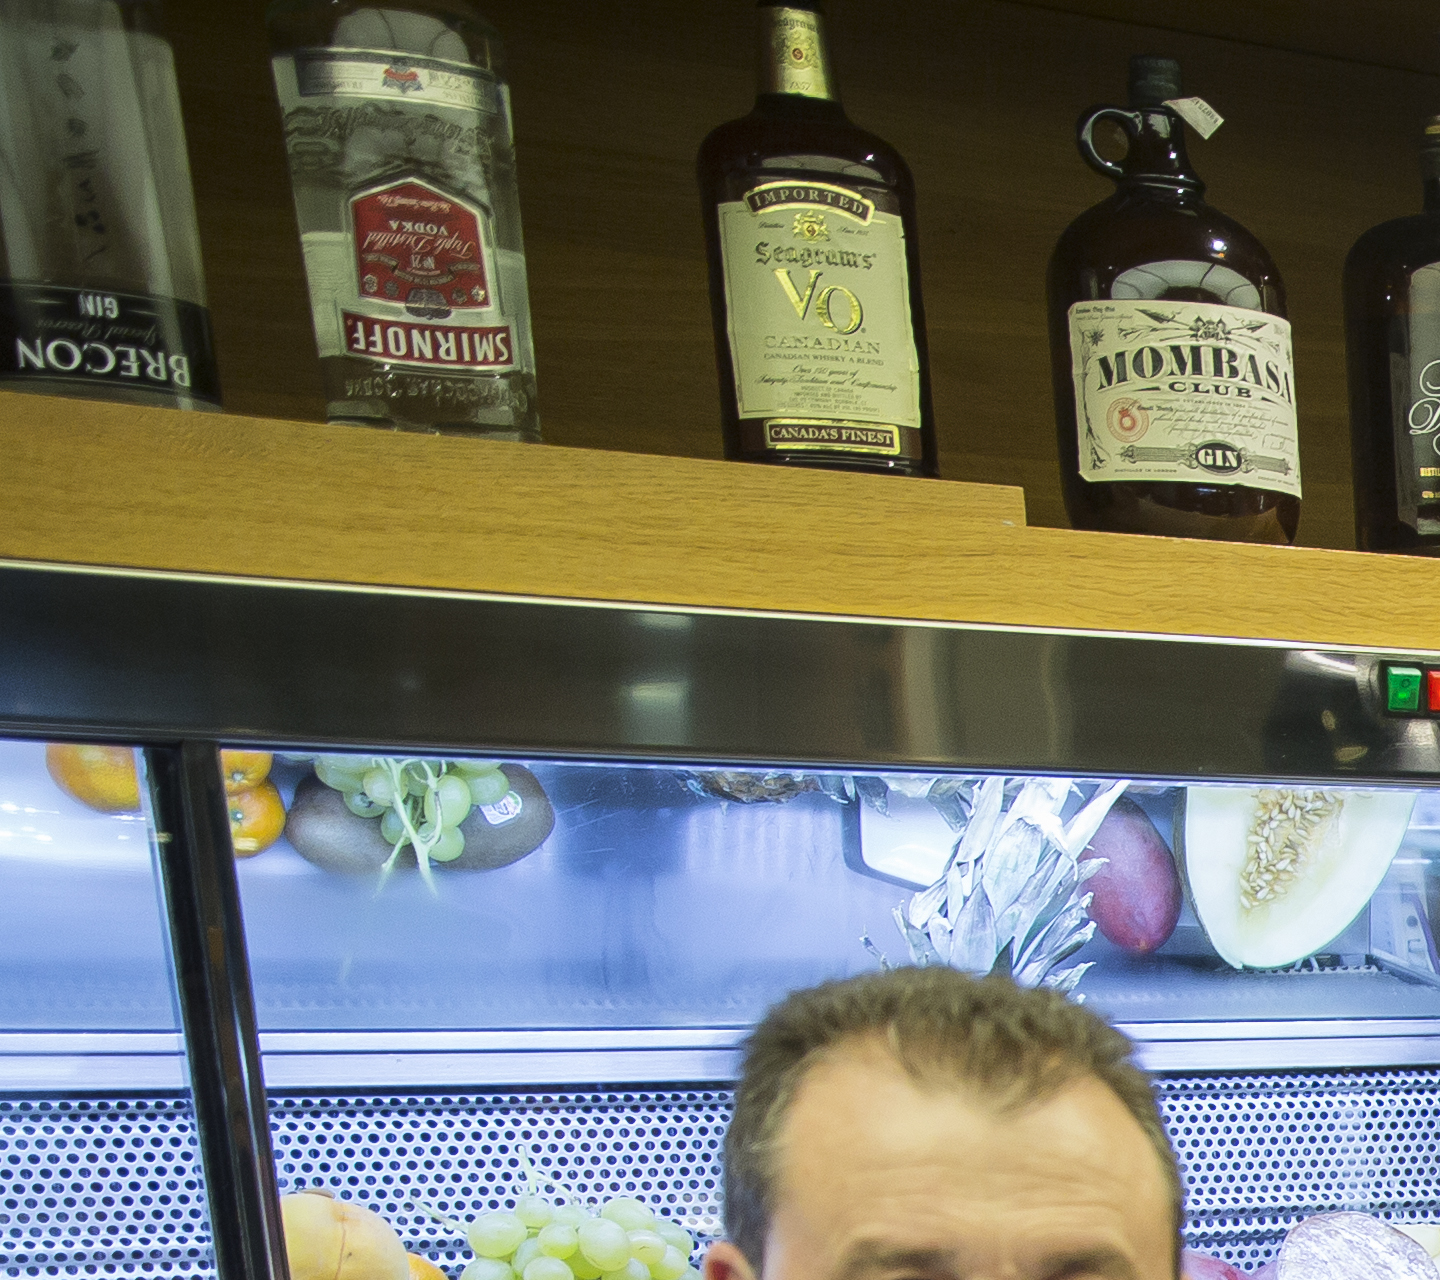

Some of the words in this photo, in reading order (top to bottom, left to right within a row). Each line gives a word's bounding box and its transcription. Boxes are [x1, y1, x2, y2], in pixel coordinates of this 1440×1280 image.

[754, 187, 864, 215] IMPORTED
[389, 219, 448, 235] VODKA
[362, 231, 432, 254] Distilled
[434, 231, 476, 259] Triple
[755, 241, 877, 271] Seagram's
[78, 293, 119, 319] GIN
[773, 268, 864, 335] VO
[353, 321, 509, 362] SMIRNOFF
[763, 335, 881, 354] CANADIAN
[16, 337, 192, 387] BRECON
[763, 353, 810, 361] CANADIAN
[1168, 381, 1252, 399] CLUB
[771, 427, 838, 440] CANADA'S
[841, 430, 893, 444] FINEST
[1198, 448, 1238, 467] GIN
